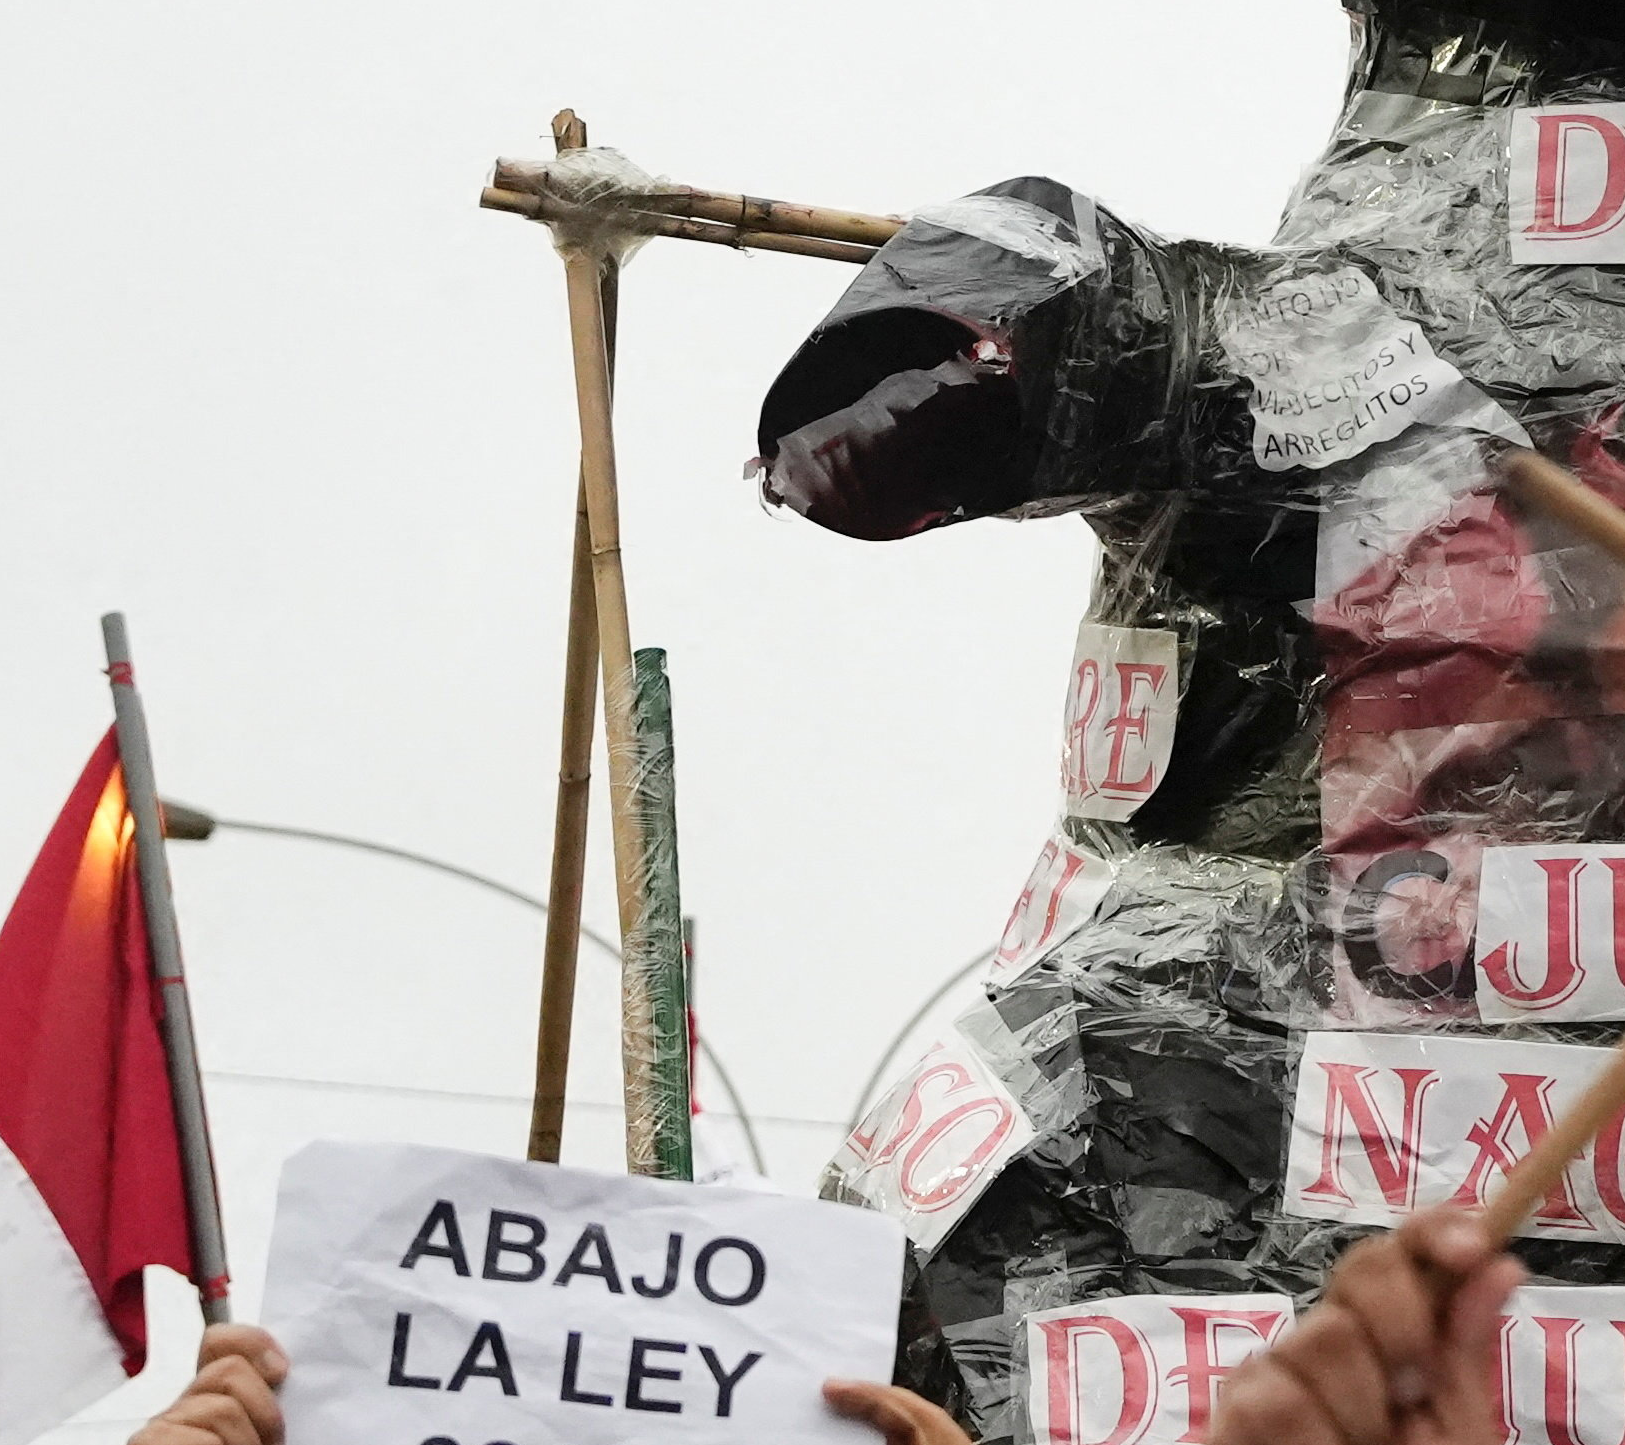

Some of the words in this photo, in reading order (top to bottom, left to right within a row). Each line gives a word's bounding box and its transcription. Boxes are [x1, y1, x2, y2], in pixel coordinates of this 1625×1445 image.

[1398, 332, 1416, 355] Y
[1264, 374, 1429, 460] ARREGLITOS
[398, 1198, 768, 1308] ABAJO
[387, 1311, 519, 1397] LA
[559, 1329, 764, 1418] LEY
